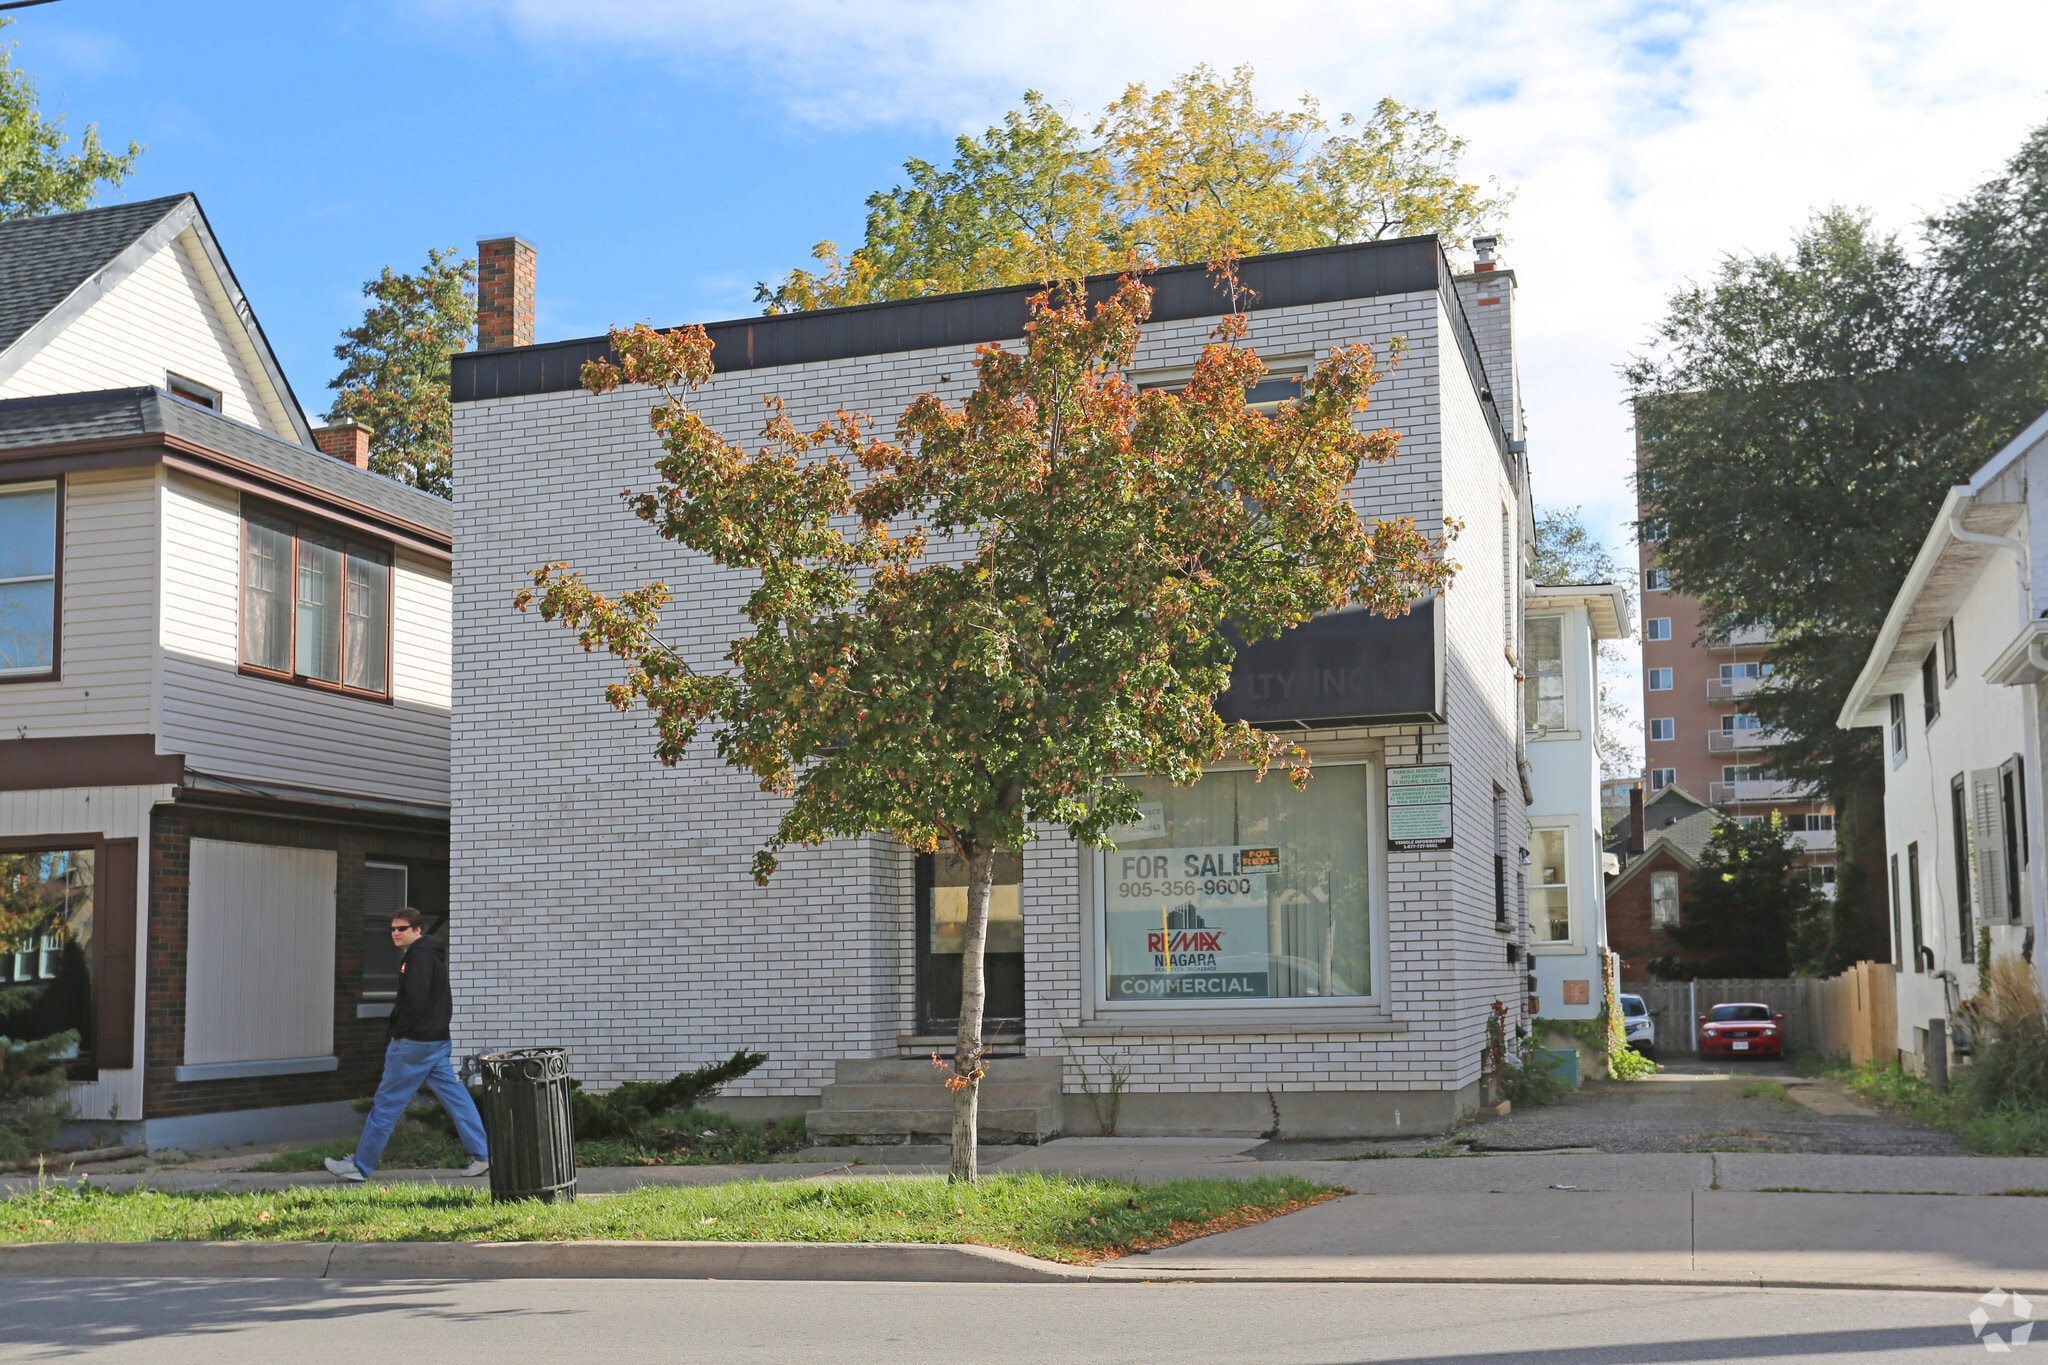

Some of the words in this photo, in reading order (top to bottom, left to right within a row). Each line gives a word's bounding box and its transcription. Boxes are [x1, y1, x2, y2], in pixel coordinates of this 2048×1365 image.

[1242, 857, 1277, 866] RENT
[1249, 850, 1270, 858] FOR
[1122, 856, 1168, 880] FOR
[1184, 853, 1240, 877] SALE
[1119, 878, 1251, 898] 905-356-9600
[1154, 953, 1217, 966] NIAGARA
[1121, 976, 1254, 995] COMMERCIAL
